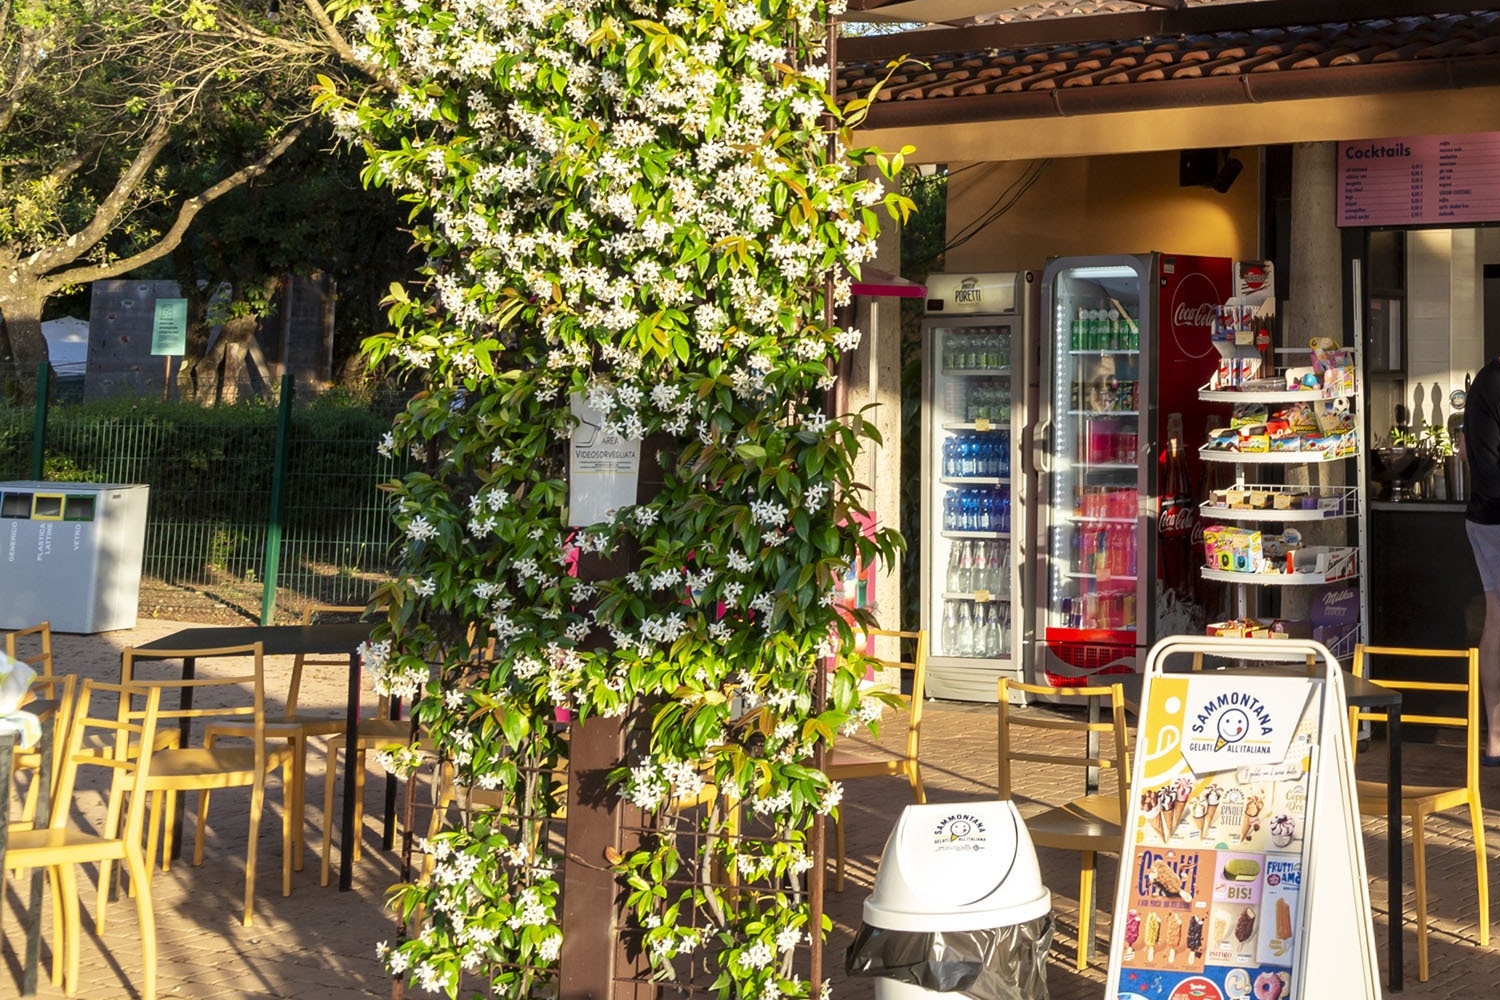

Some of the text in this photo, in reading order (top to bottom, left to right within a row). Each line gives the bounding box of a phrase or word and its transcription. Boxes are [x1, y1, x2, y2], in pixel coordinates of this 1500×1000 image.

[1345, 143, 1411, 160] Cocktails
[73, 523, 81, 551] VETRO
[1192, 691, 1273, 736] SAMMONTANA
[1189, 743, 1271, 754] GELATI ALL'ITALIANA
[934, 814, 986, 835] SAMMONTANA
[1267, 861, 1294, 874] FRUTTI
[1227, 887, 1252, 900] BIS!
